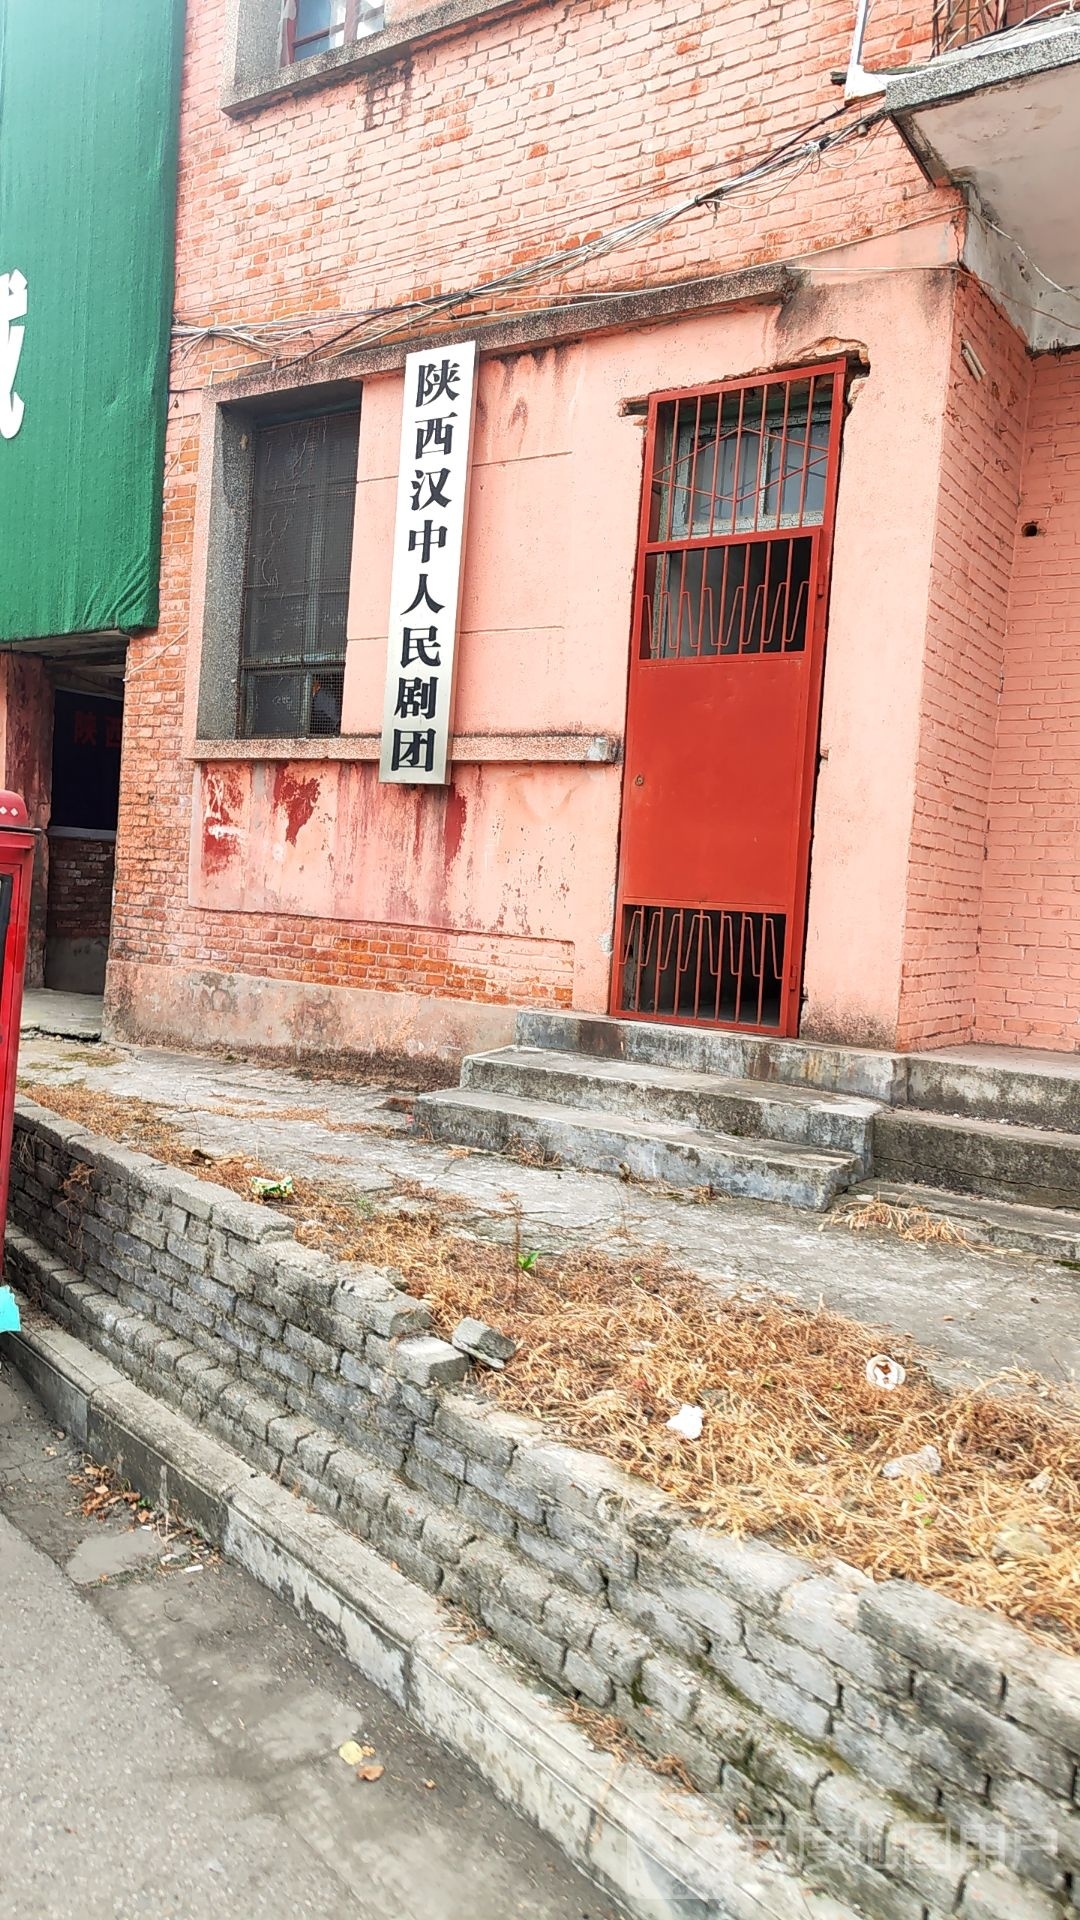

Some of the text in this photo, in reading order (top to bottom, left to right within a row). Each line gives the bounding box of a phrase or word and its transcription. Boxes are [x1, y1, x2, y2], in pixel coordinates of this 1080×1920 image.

[391, 359, 461, 772] 陕西汉中人民剧团
